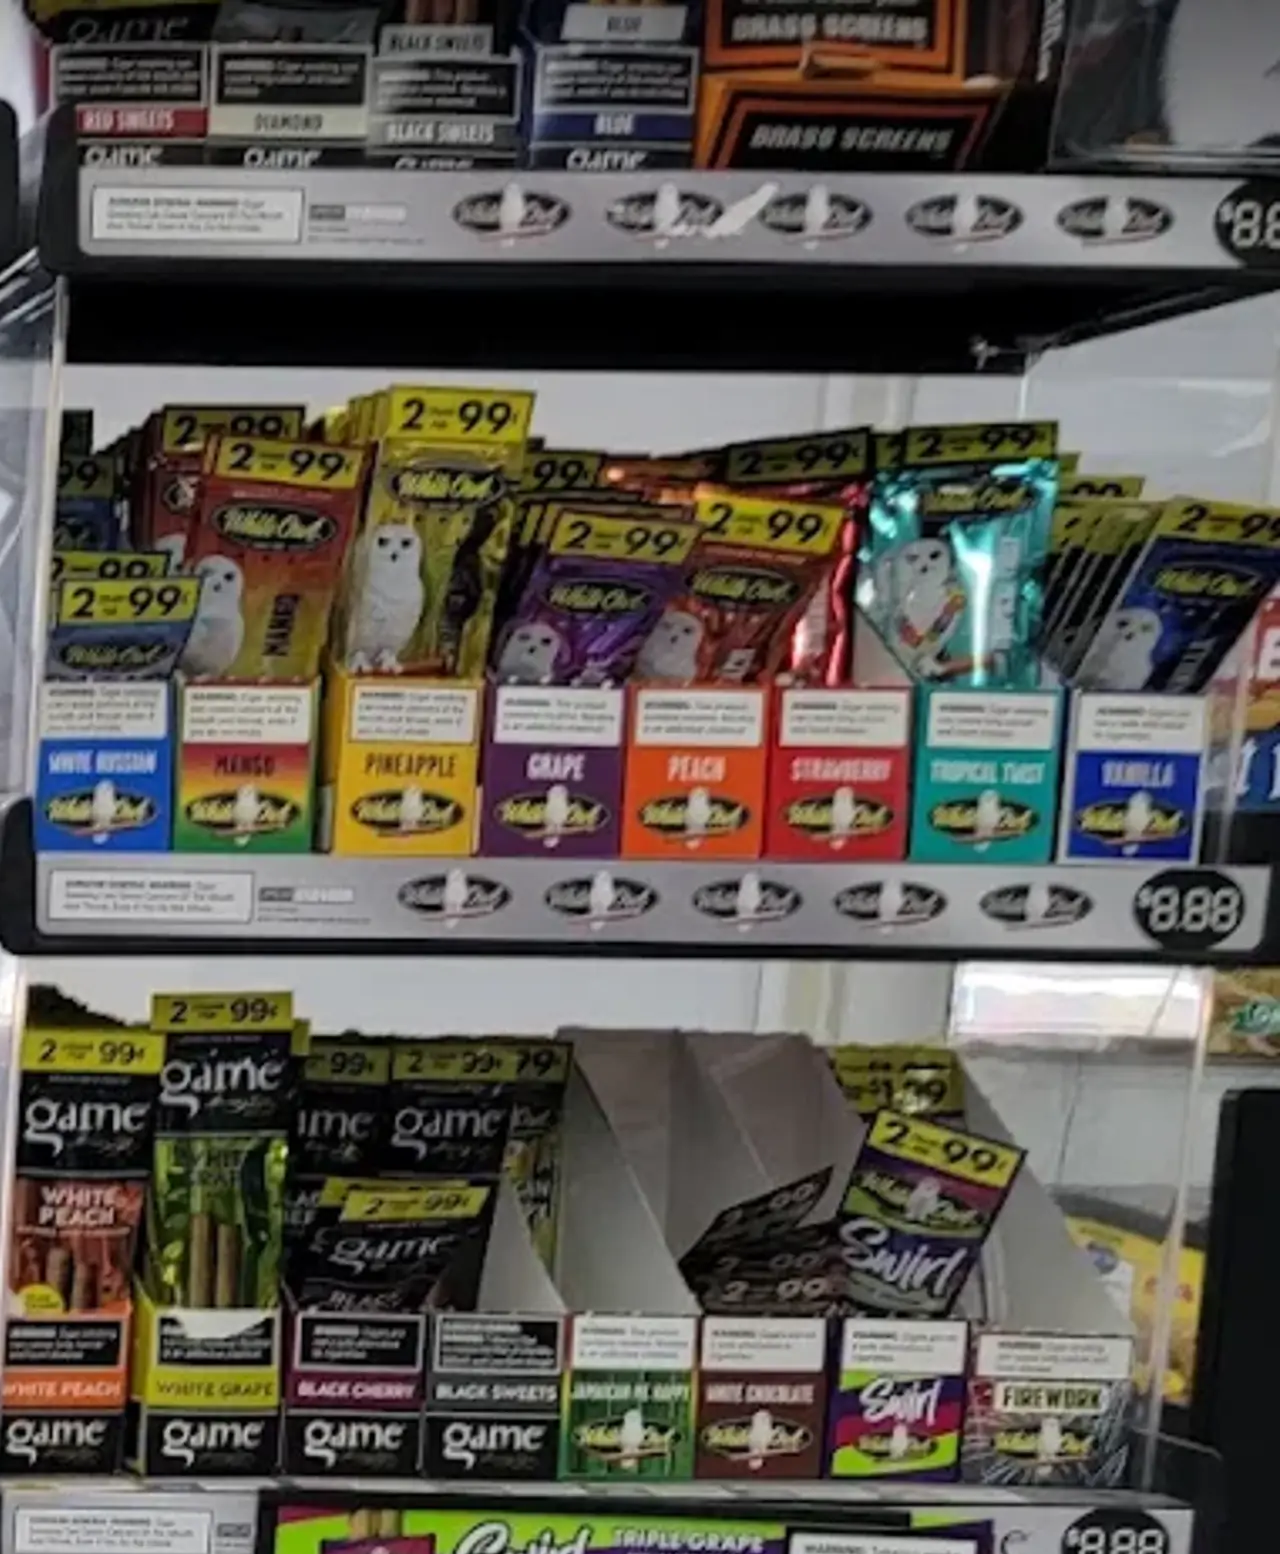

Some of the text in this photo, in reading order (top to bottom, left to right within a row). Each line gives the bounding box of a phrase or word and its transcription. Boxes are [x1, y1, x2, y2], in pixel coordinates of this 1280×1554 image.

[751, 125, 950, 152] BRASS SCREENS
[49, 751, 157, 774] WHITE RUSSIAN
[215, 755, 275, 778] MANGO
[365, 755, 455, 778] PINEAPPLE
[527, 755, 583, 781] GRAPE
[667, 757, 725, 782] PEACH
[791, 758, 890, 782] STRAWBERRY
[931, 762, 996, 785] TROPICAL
[1102, 762, 1175, 786] VANILLA
[3, 1381, 121, 1398] WHITE PEACH
[157, 1381, 274, 1398] WHITE GRAPE
[298, 1381, 416, 1400] BLACK CHERRY
[437, 1383, 557, 1402] BLACK SWEETS
[706, 1384, 814, 1405] WHITE CHOCOLATE
[1002, 1387, 1101, 1409] FIREWORK
[859, 1379, 941, 1424] Swirl
[5, 1417, 109, 1465] game
[441, 1418, 544, 1466] game
[612, 1528, 764, 1554] TRIPLE GRAPE
